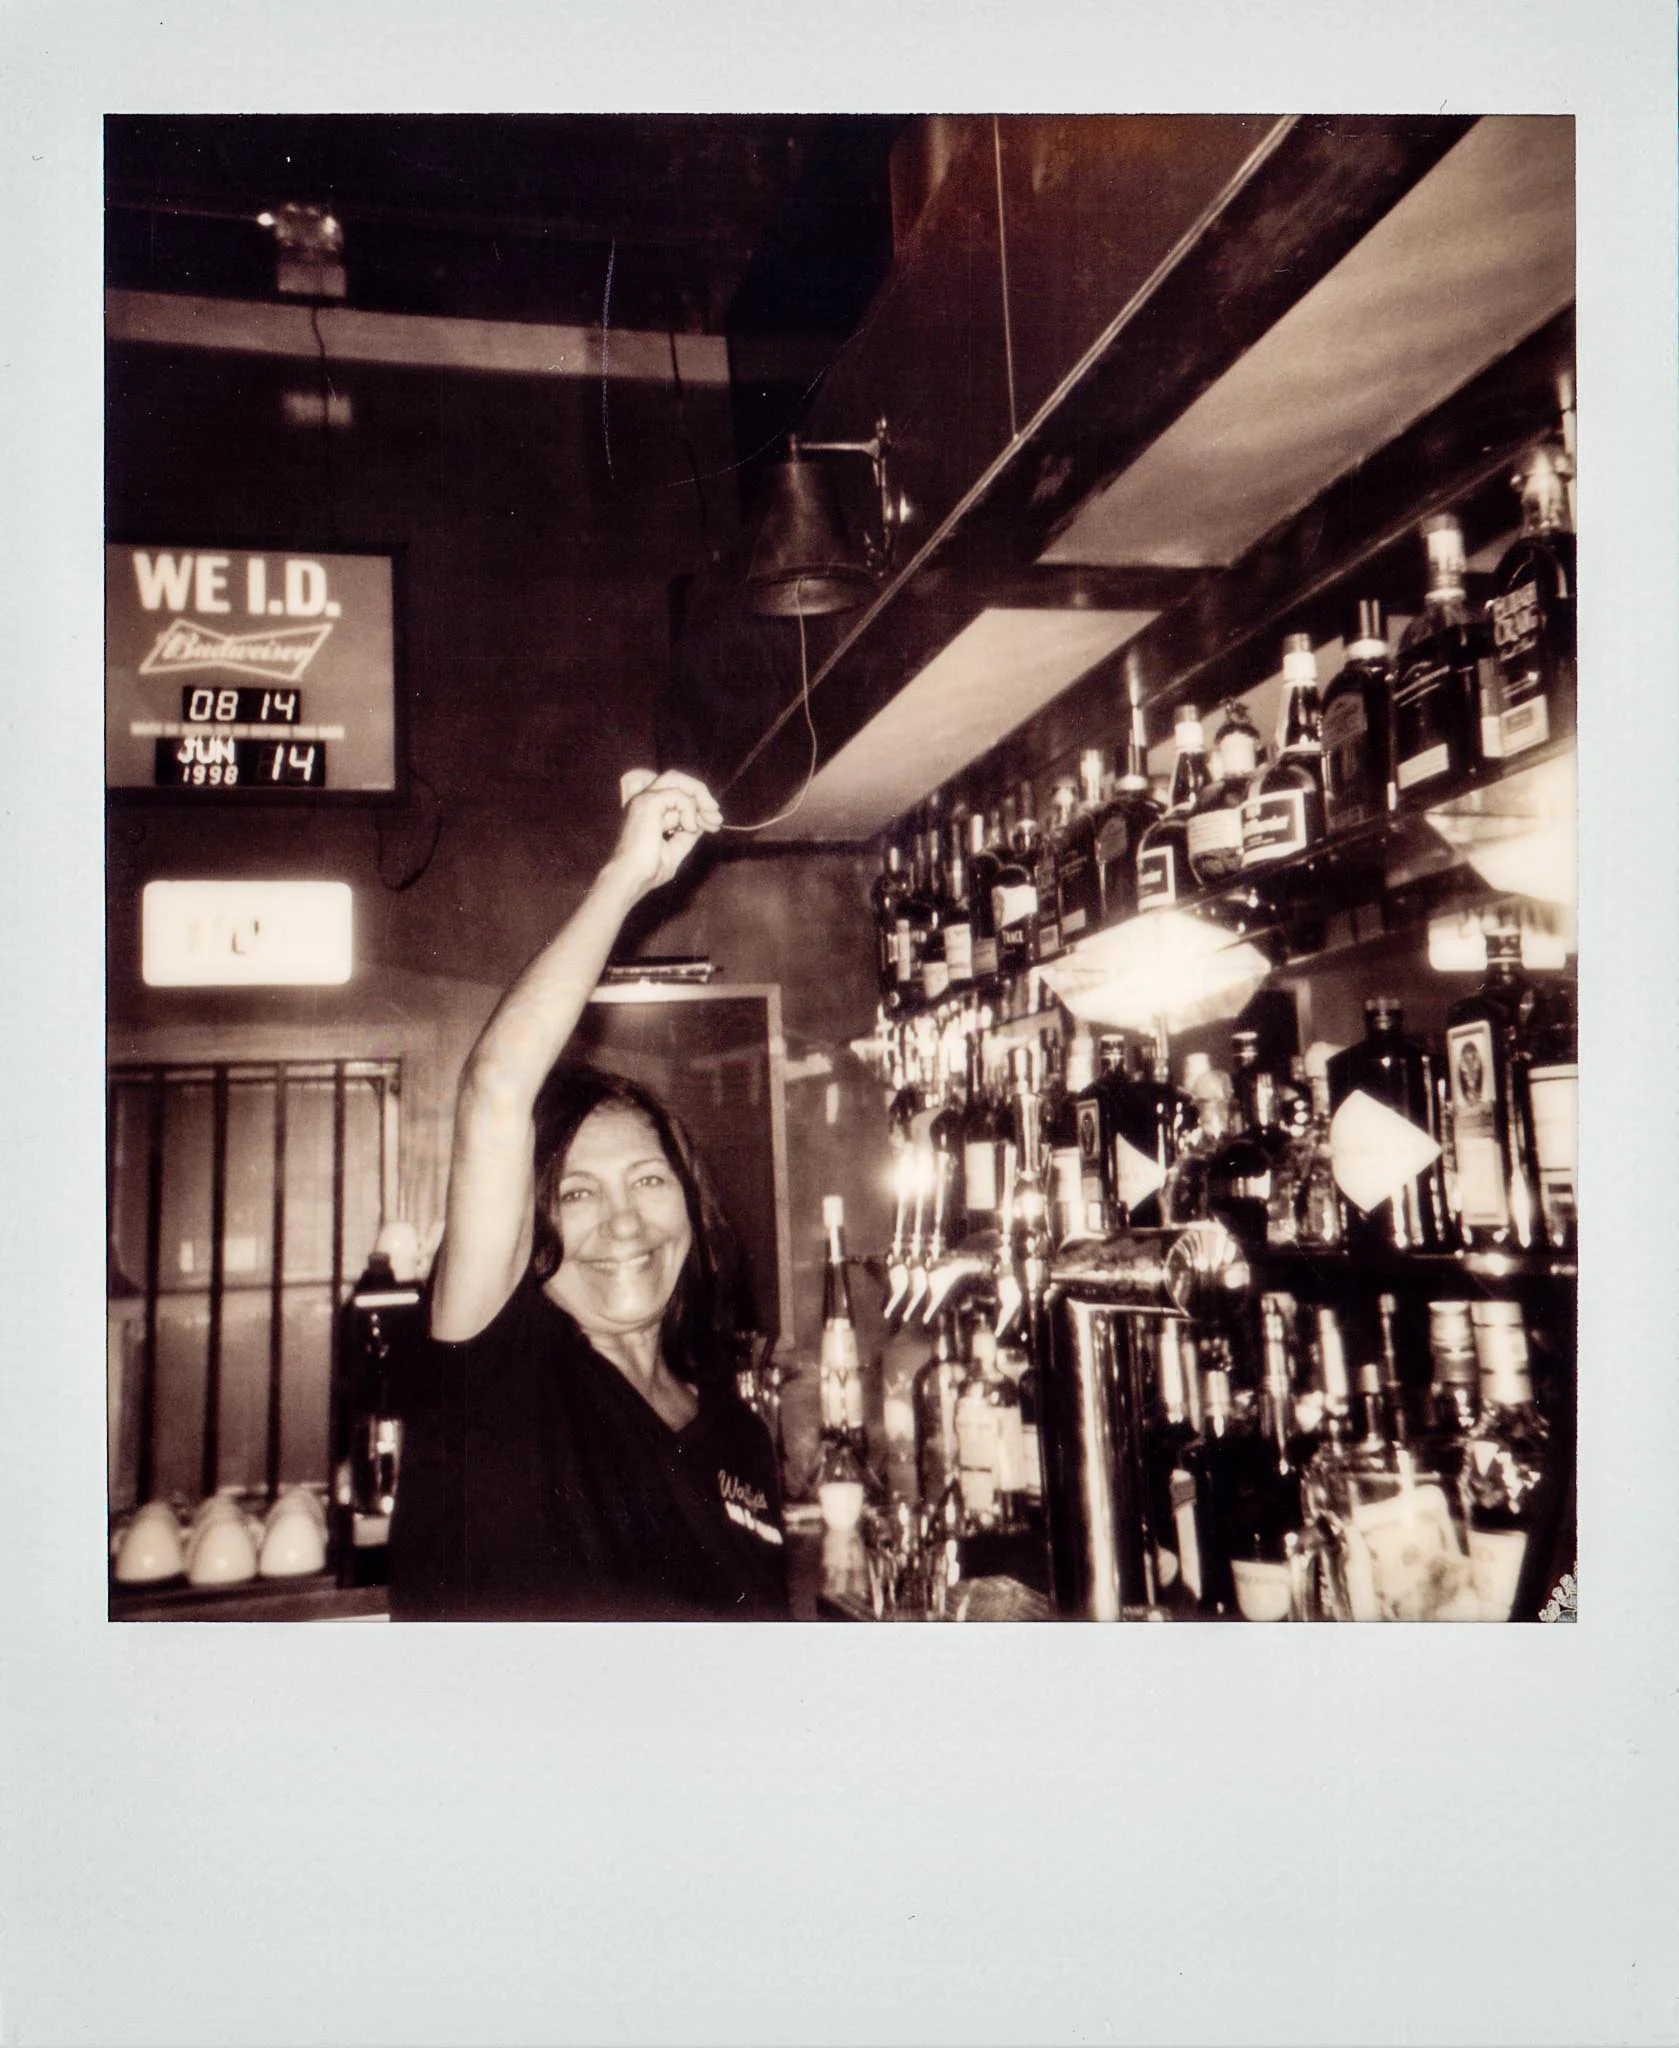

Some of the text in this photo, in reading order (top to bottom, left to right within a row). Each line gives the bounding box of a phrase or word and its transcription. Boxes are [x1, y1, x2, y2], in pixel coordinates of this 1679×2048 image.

[133, 552, 342, 617] WE I.D.
[158, 632, 314, 662] Budweiser
[189, 689, 296, 721] 08 14
[177, 736, 315, 782] JUN 14
[182, 764, 239, 785] 1998
